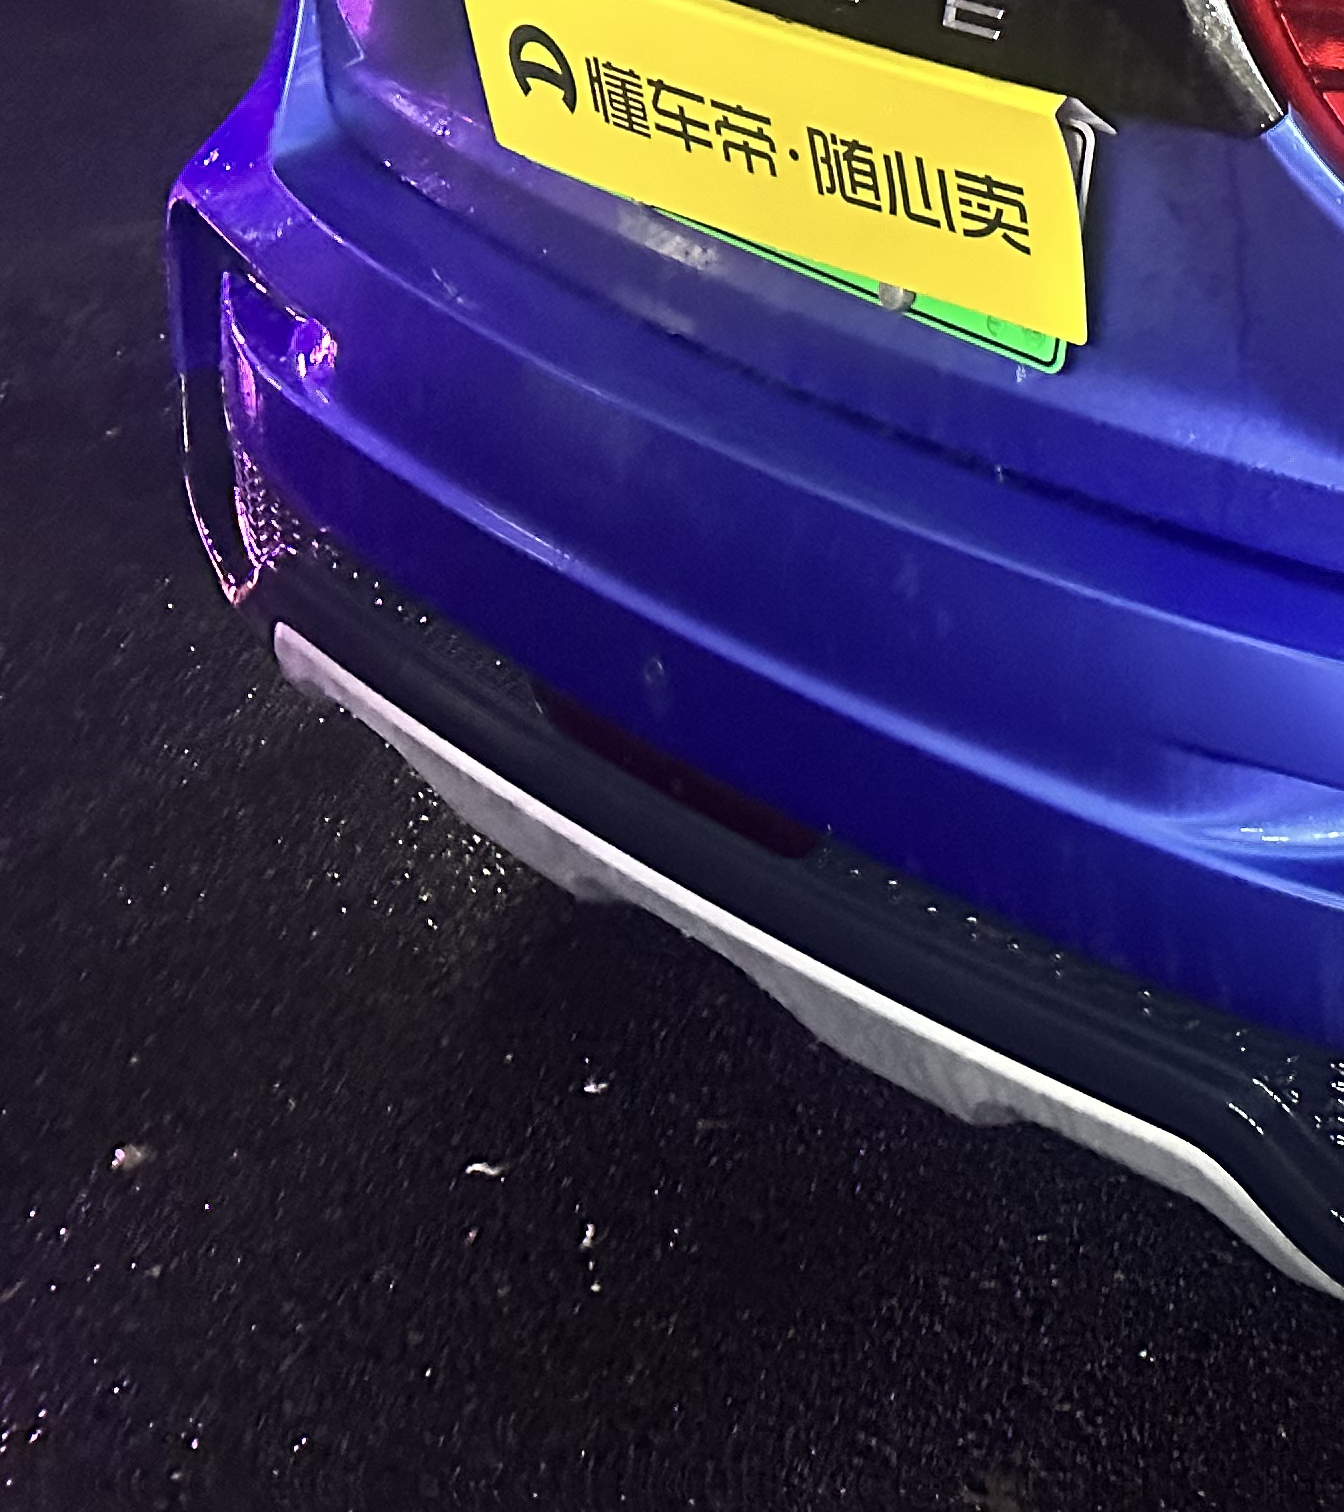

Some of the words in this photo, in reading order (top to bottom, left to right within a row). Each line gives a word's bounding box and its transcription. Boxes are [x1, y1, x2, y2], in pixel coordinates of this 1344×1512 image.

[584, 55, 1032, 255] 懂车帝·随心卖
